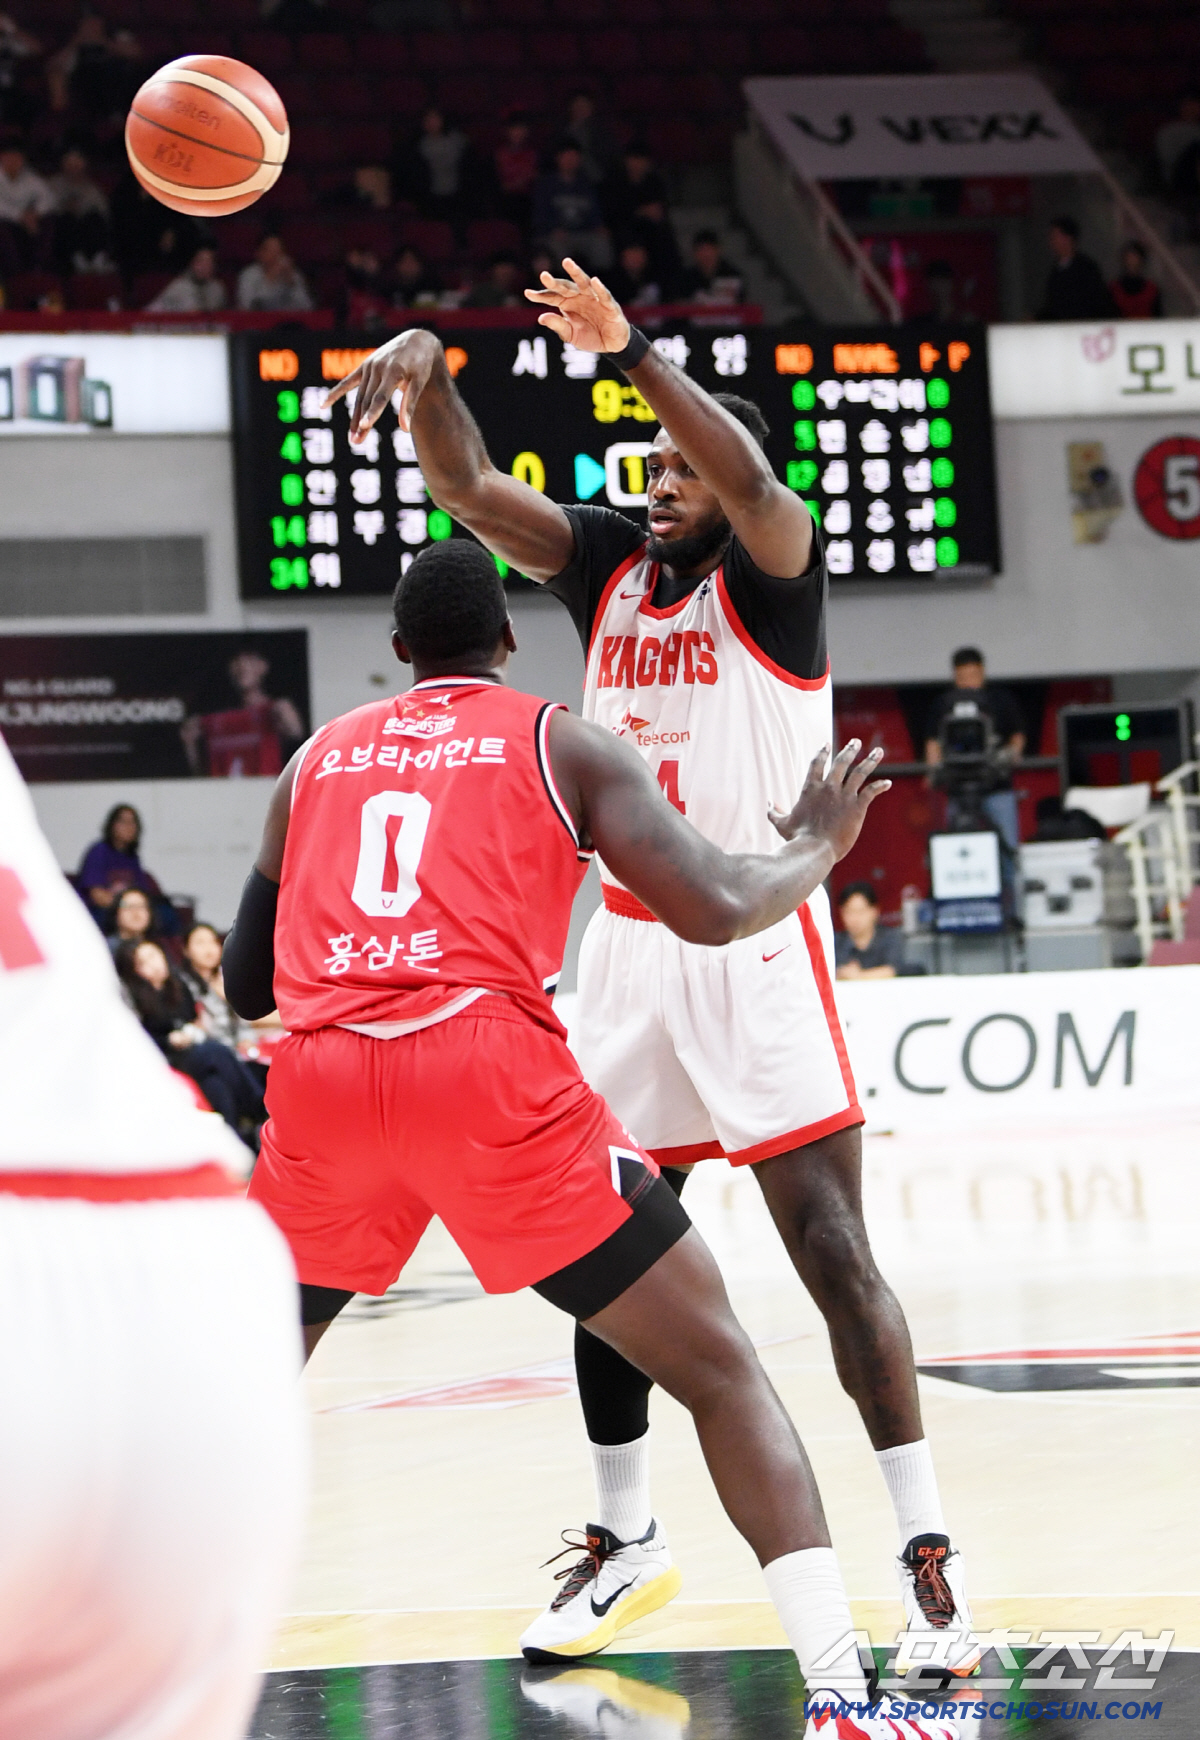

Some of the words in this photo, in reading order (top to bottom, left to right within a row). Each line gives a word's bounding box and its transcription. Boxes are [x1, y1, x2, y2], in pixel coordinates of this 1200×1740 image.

[1165, 454, 1200, 522] 5
[597, 630, 719, 690] KNGHTS
[315, 736, 507, 780] 오브라이언트
[350, 789, 432, 918] 0
[323, 928, 443, 976] 홍삼톤
